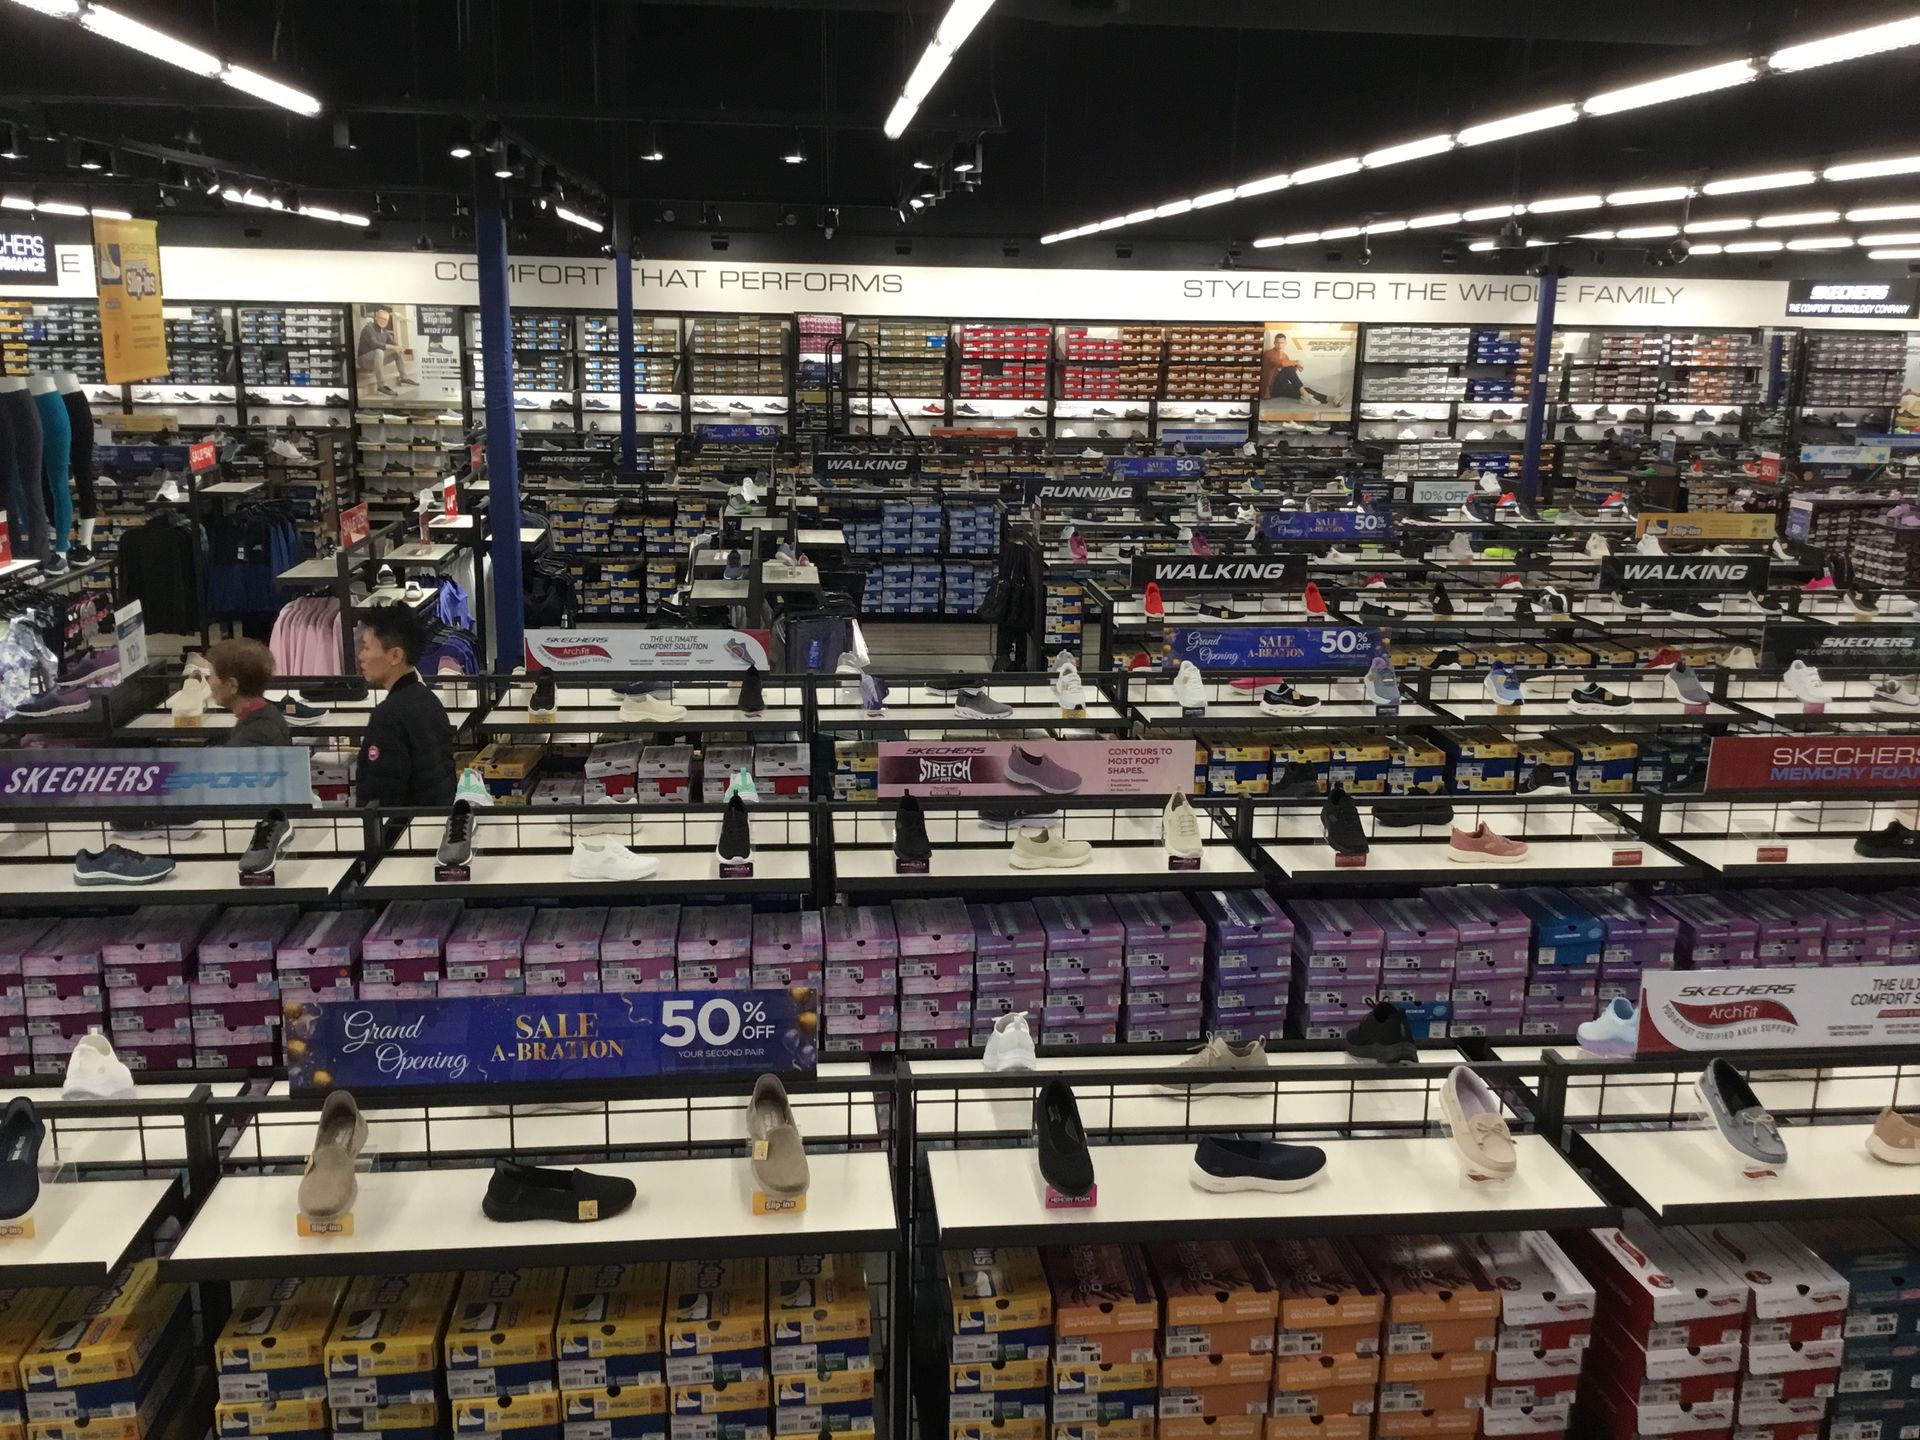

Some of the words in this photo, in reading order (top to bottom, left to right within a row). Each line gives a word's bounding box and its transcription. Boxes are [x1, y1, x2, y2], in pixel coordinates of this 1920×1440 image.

[435, 261, 607, 286] COFORT
[720, 270, 902, 293] PERFORMS
[1183, 280, 1301, 299] STYLES
[1314, 282, 1376, 300] FOR
[1388, 283, 1448, 301] THE
[1578, 285, 1684, 305] FAMILY
[1809, 285, 1890, 300] SKECHERS
[1801, 304, 1831, 313] COMFORT
[1831, 304, 1875, 314] TECHNOLOGY
[1874, 304, 1910, 314] COMPANY
[827, 460, 908, 470] WALKING
[1039, 486, 1133, 498] RUNNING
[1420, 491, 1443, 501] 10%
[1444, 490, 1468, 501] OFF
[1315, 518, 1338, 526] SALE
[1672, 525, 1702, 536] Slip-ins
[1155, 563, 1285, 579] WALKING
[1623, 564, 1749, 580] WALKING
[1185, 631, 1222, 652] Grand
[1258, 635, 1296, 647] SALE
[1320, 630, 1369, 653] 50%
[1821, 637, 1916, 647] SKECHERS
[1199, 647, 1239, 665] Opening
[1247, 648, 1305, 658] A-BRATION
[1108, 757, 1133, 765] MOST
[1135, 757, 1160, 765] FOOT
[919, 757, 973, 782] STRETCH
[1770, 766, 1867, 780] MEMORY
[4, 766, 160, 793] SKECHERS
[160, 770, 288, 788] SPORT
[1679, 984, 1797, 996] SKECHERS
[1873, 978, 1898, 991] THE
[1851, 993, 1912, 1006] COMFORT
[342, 1010, 425, 1053] Grand
[515, 1012, 600, 1040] SALE
[742, 1025, 775, 1039] OFF
[1696, 1030, 1735, 1041] CERTIFIED
[1737, 1026, 1759, 1037] ARCH
[1760, 1023, 1797, 1035] SUPPORT
[375, 1042, 470, 1080] Opening
[490, 1039, 625, 1062] A-BRATION
[705, 1049, 743, 1058] SECOND
[744, 1048, 765, 1056] PAIR
[766, 1202, 796, 1211] Slip-ins
